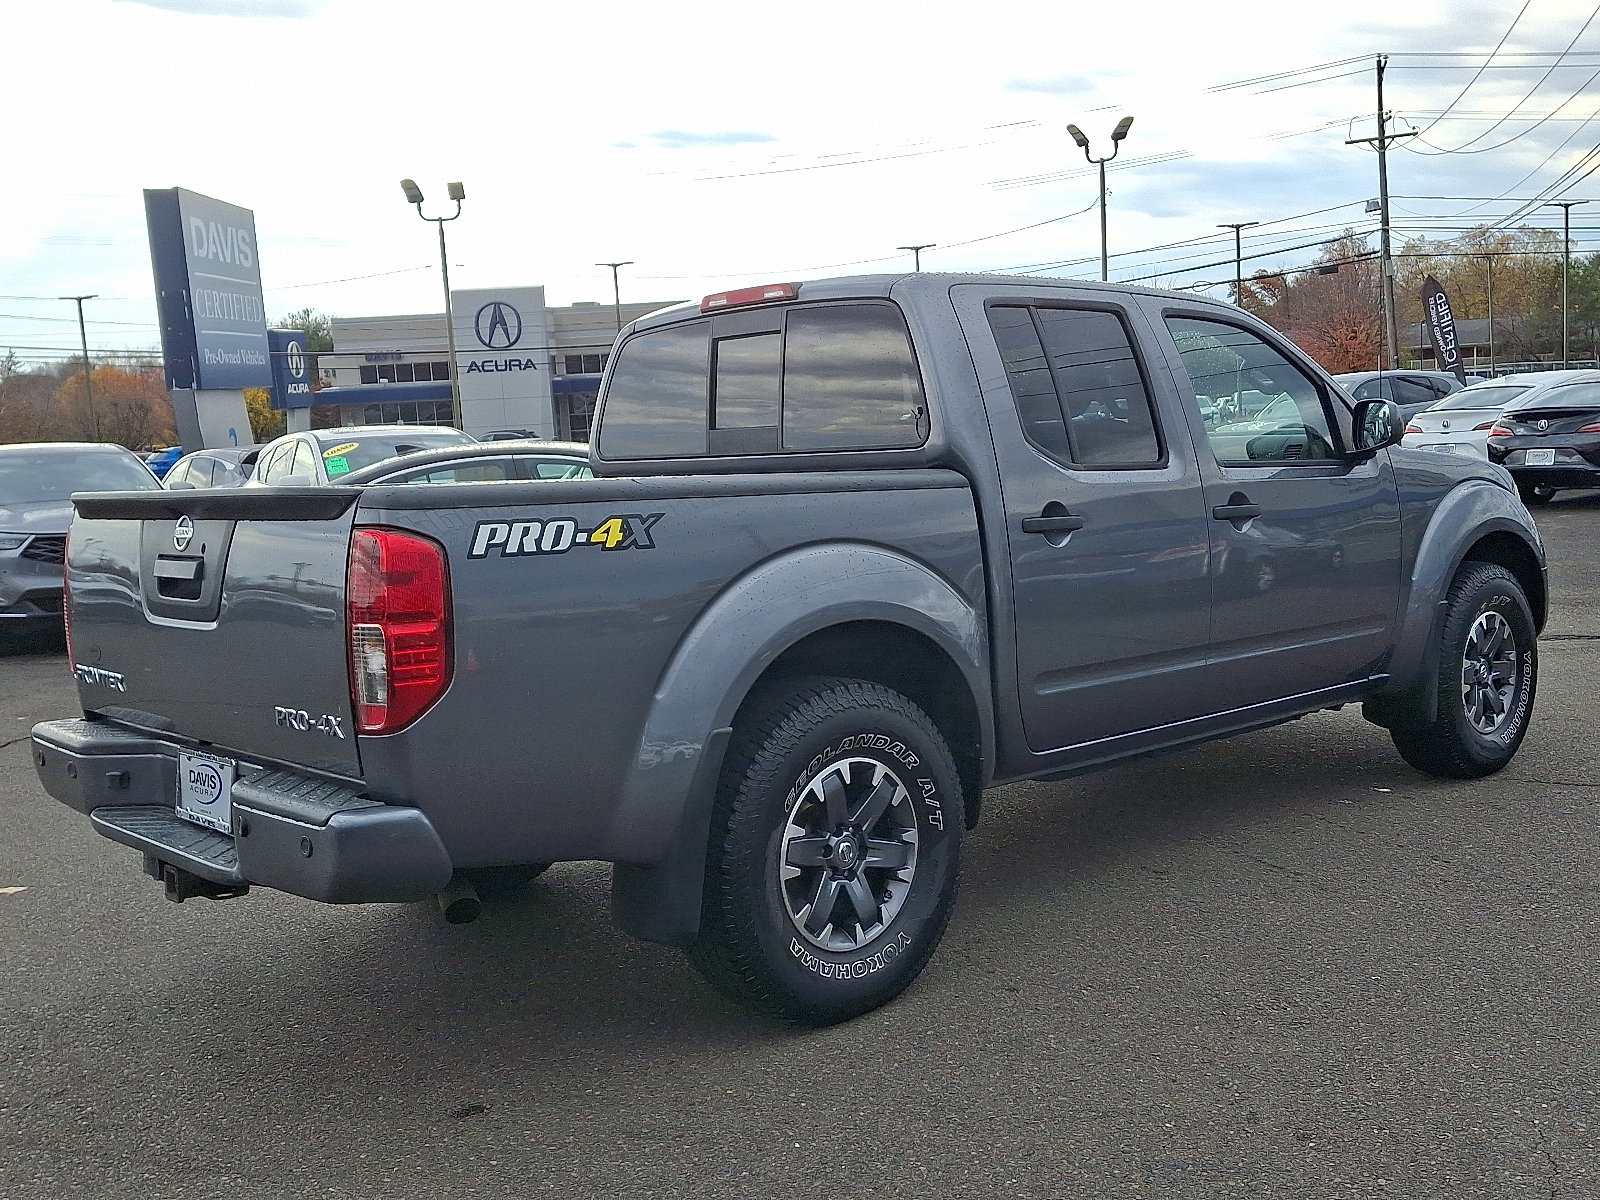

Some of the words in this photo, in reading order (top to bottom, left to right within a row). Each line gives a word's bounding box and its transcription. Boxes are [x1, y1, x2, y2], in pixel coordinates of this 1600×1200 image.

[190, 216, 253, 267] DAVIS
[195, 288, 262, 323] CERTIFIED
[204, 348, 241, 364] Pre-Owned
[242, 350, 266, 365] Vehicles
[466, 358, 537, 374] ACURA
[287, 382, 310, 394] ACURA
[467, 513, 666, 559] PRO-4X
[1501, 651, 1532, 744] YOKOHAMA
[274, 705, 347, 740] PRO-4X
[188, 769, 217, 790] DAVIS
[189, 785, 214, 797] ACURA
[784, 733, 920, 813] GEOLANDAR
[917, 778, 944, 831] A/T
[789, 931, 912, 979] YOKOHAMA
